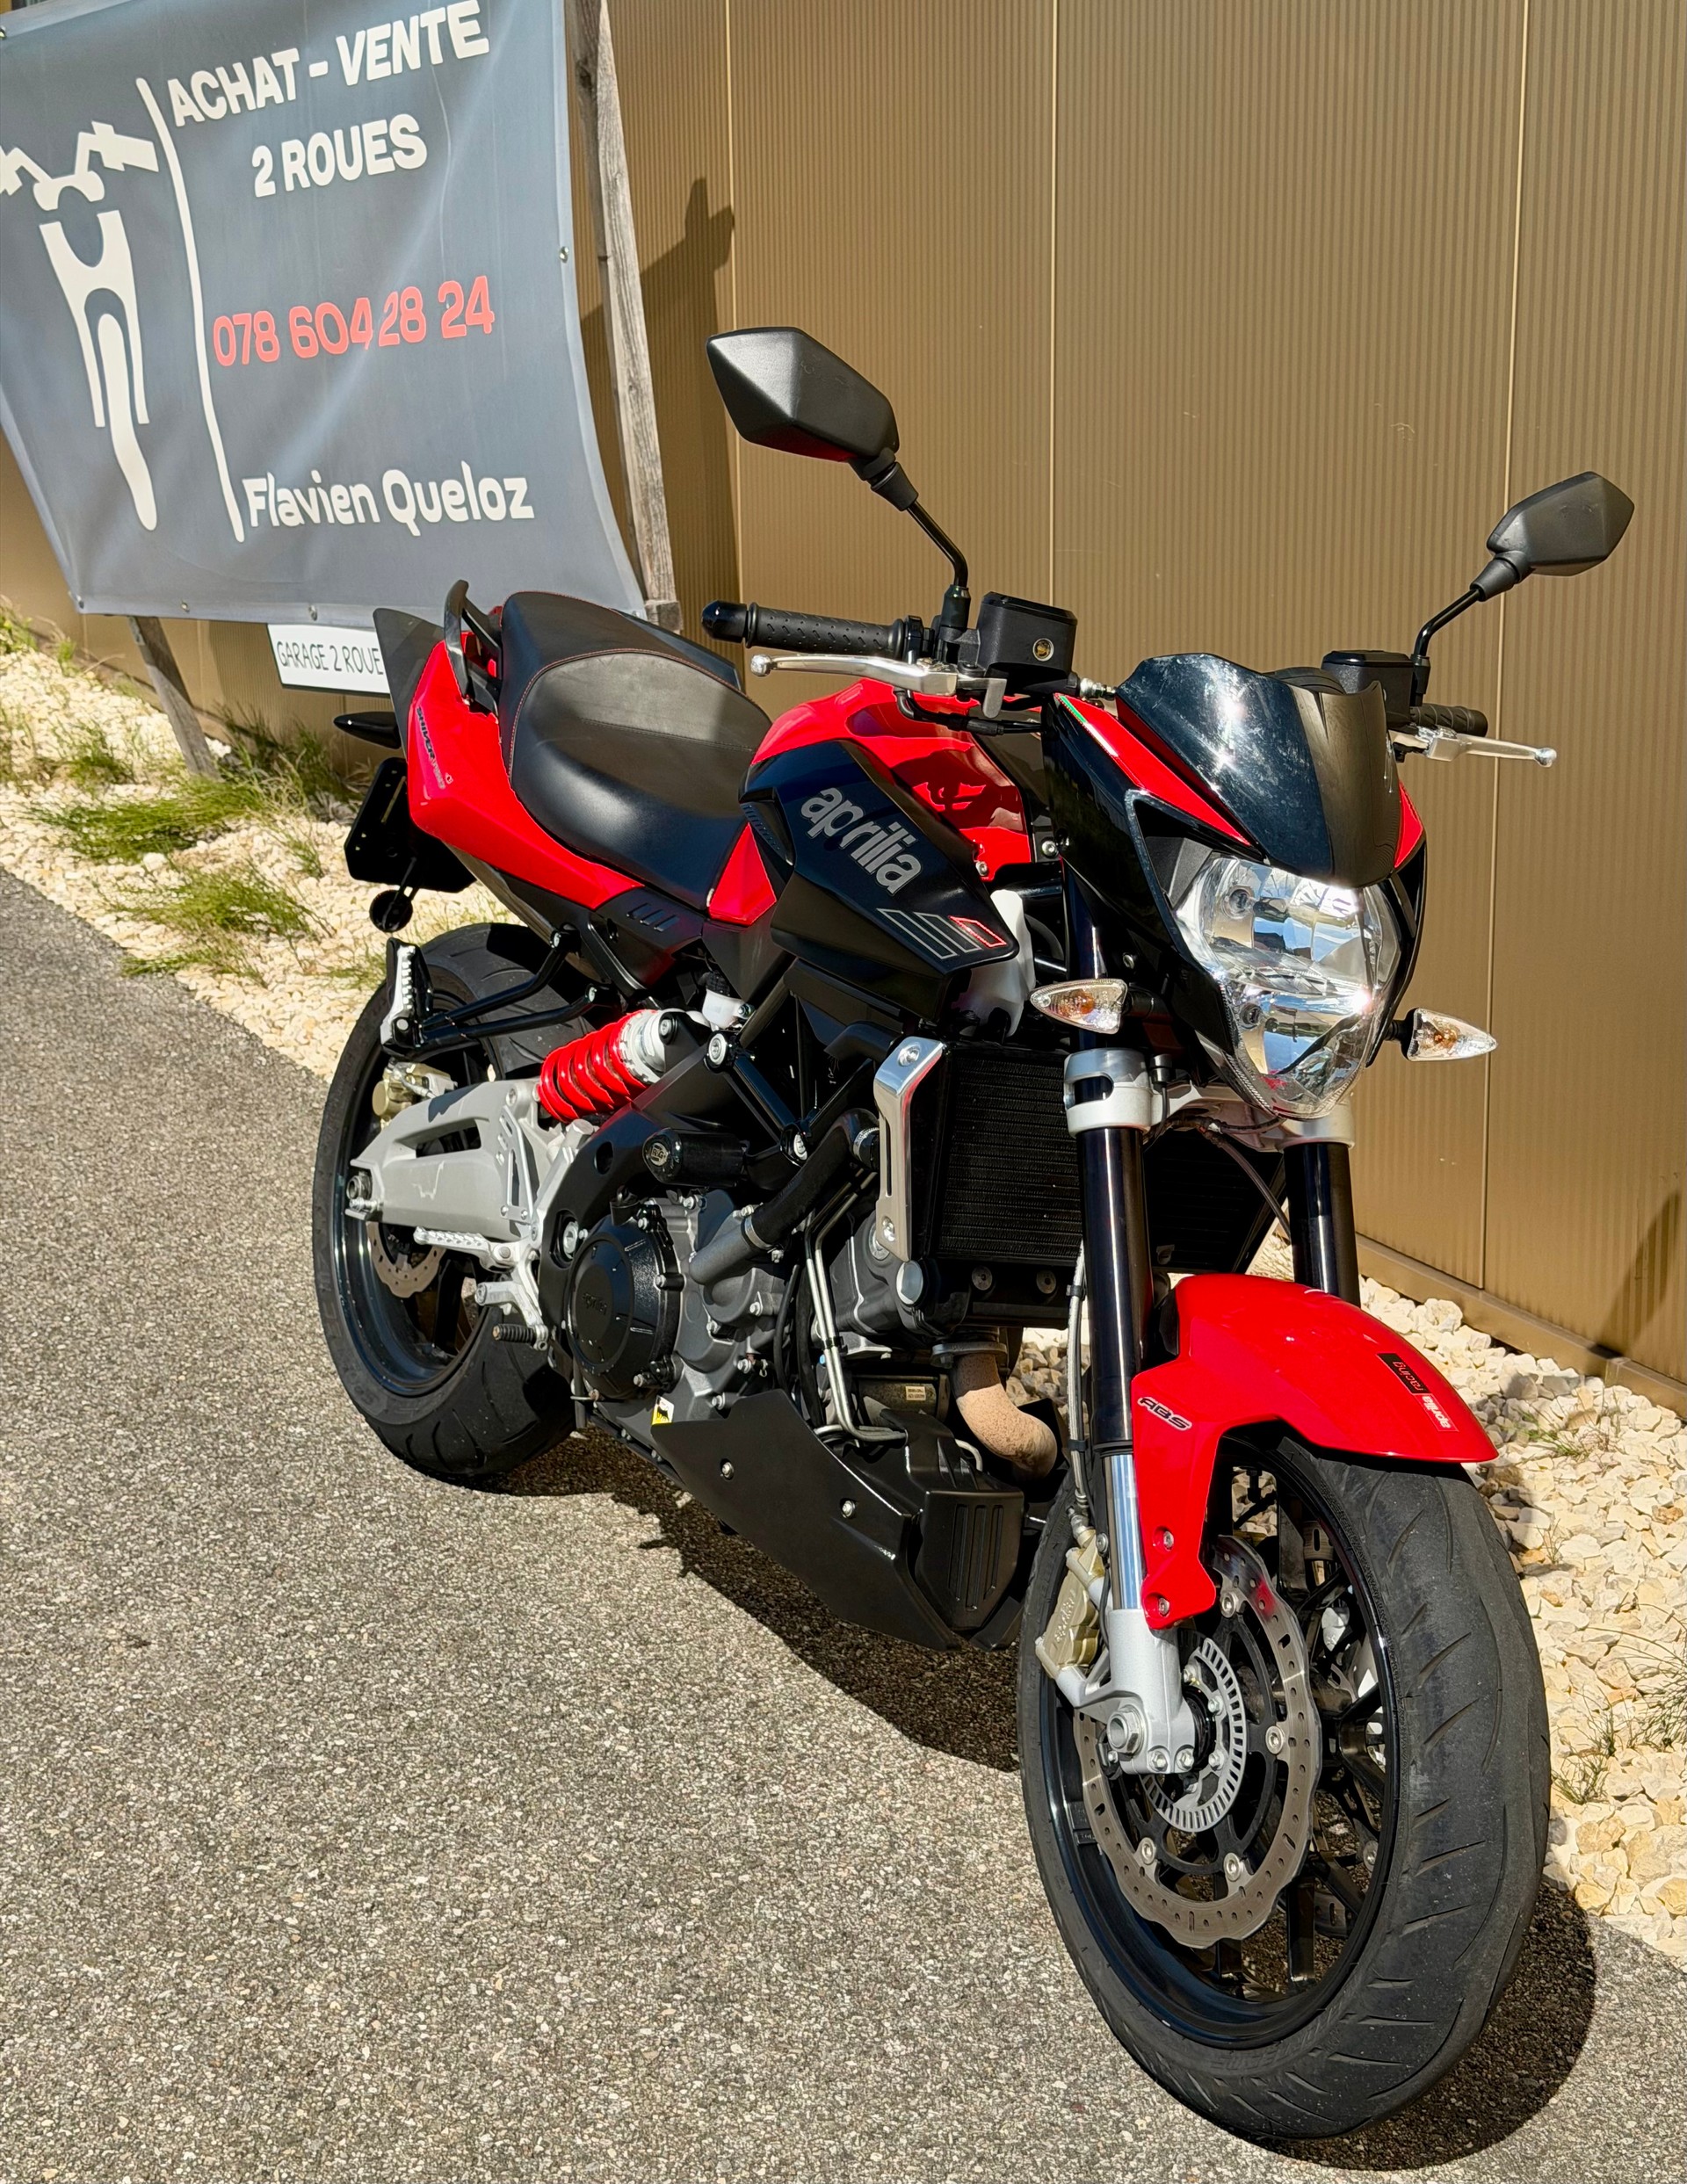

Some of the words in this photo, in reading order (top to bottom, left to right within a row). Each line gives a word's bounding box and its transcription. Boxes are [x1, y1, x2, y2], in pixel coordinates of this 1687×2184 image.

[168, 48, 300, 127] ACHAT
[309, 62, 329, 78] -
[337, 0, 490, 86] VENTE
[252, 146, 276, 198] 2
[282, 114, 427, 191] ROUES
[214, 310, 280, 366] 078
[438, 276, 495, 339] 24
[242, 470, 380, 527] Flavien
[382, 461, 534, 536] Queloz
[276, 640, 329, 671] GARAGE
[329, 645, 343, 672] 2
[800, 787, 922, 895] aprilia
[1139, 1397, 1191, 1429] ABS
[1392, 1361, 1424, 1391] racing
[1422, 1395, 1452, 1429] aprilia
